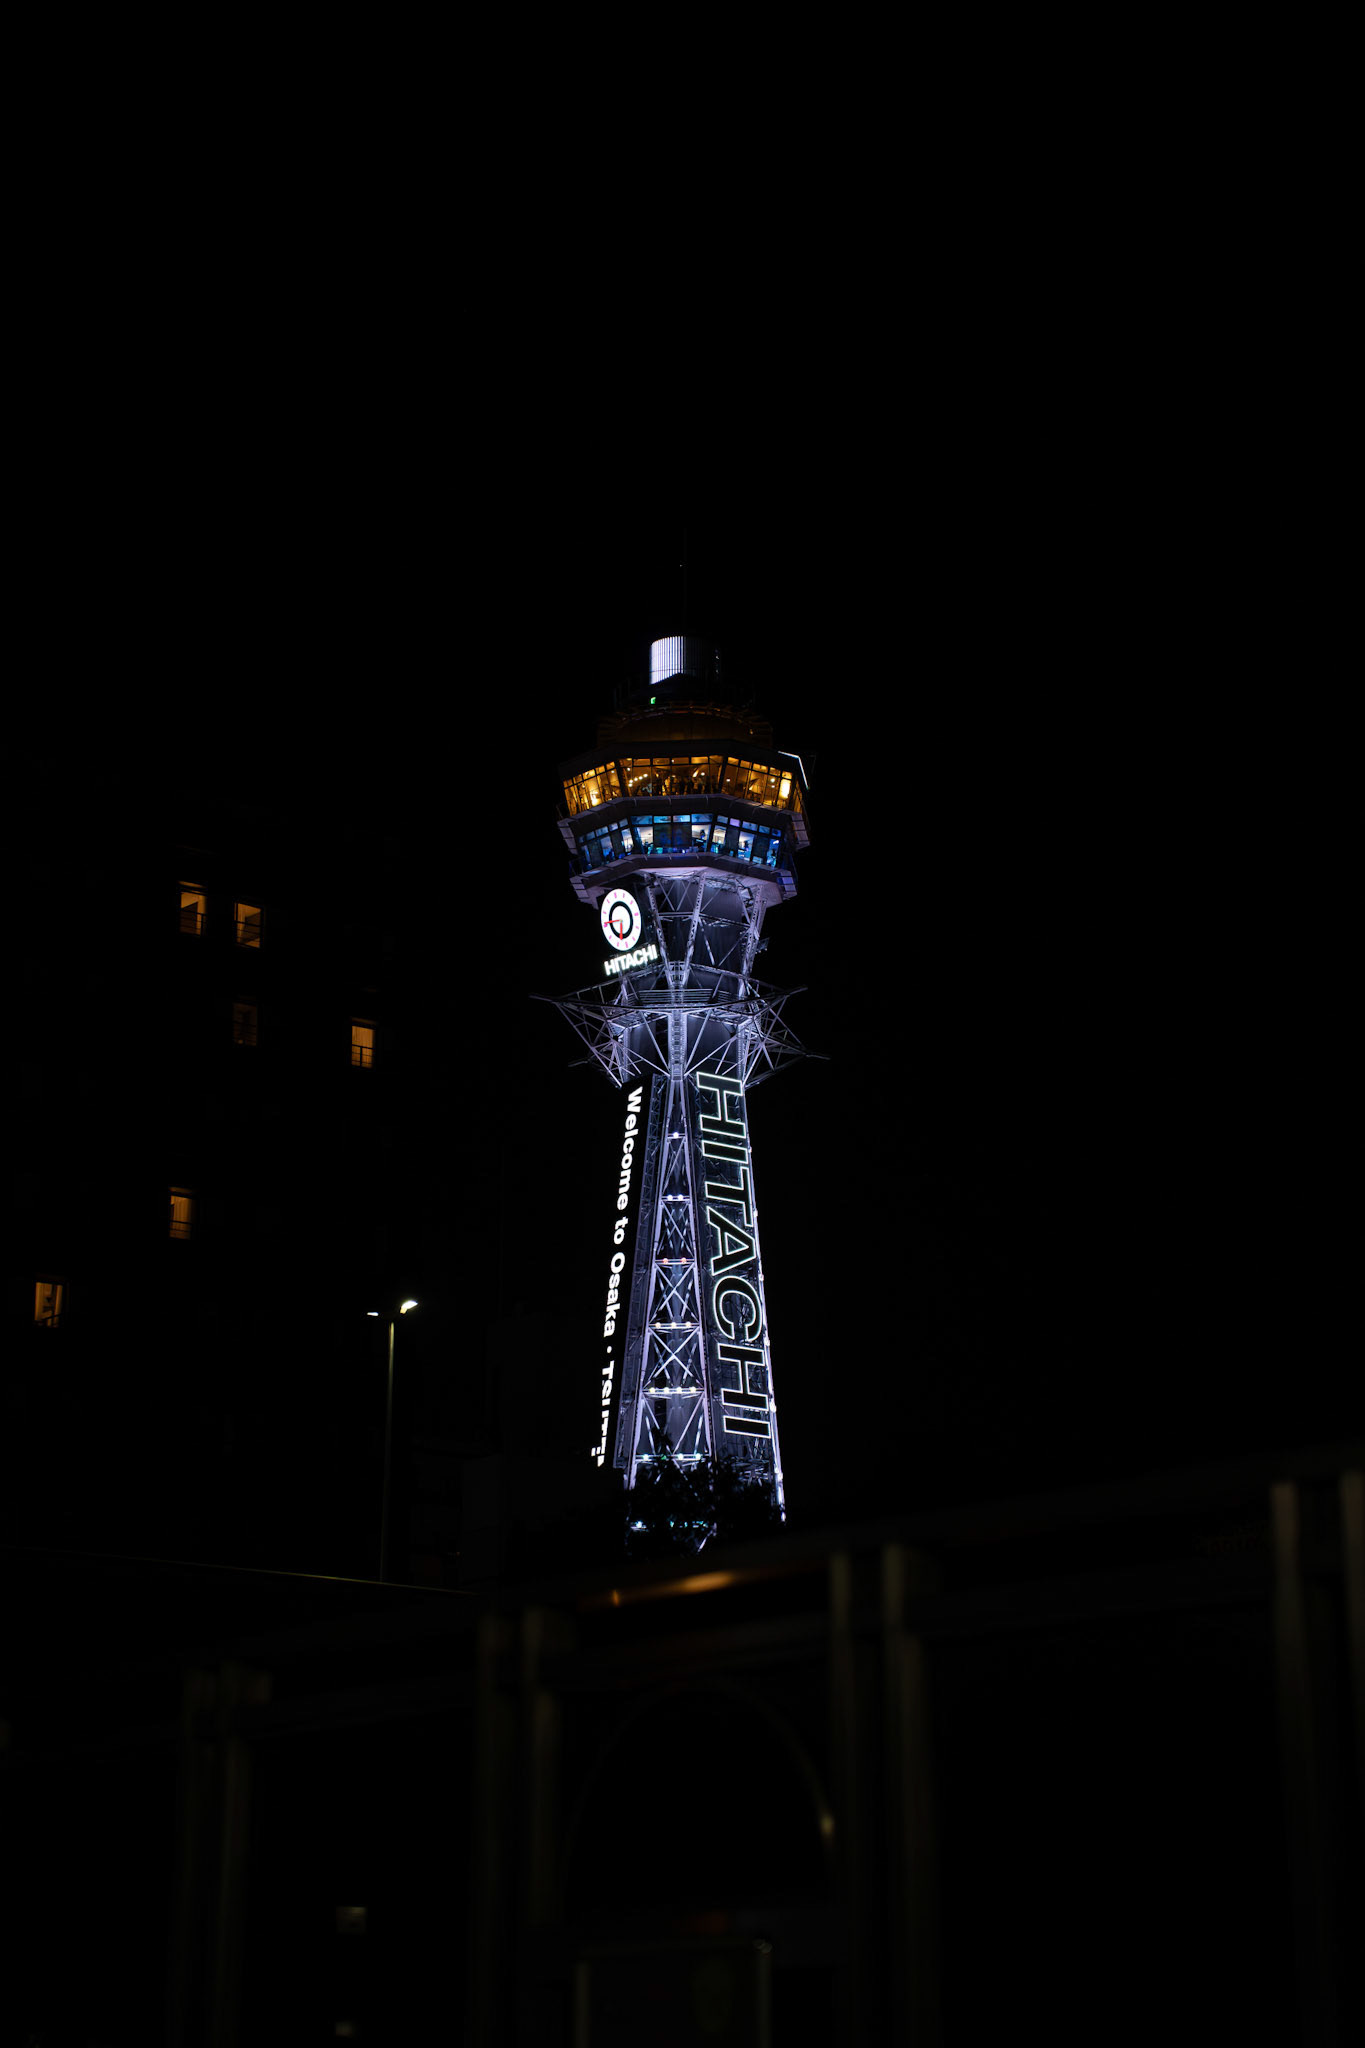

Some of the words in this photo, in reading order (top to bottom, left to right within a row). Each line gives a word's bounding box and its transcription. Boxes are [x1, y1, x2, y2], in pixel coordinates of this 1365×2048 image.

[604, 944, 658, 976] HITACHI
[616, 1085, 643, 1211] Welcome
[613, 1216, 629, 1245] to
[696, 1071, 772, 1439] HITACHI
[603, 1252, 626, 1338] Osaka
